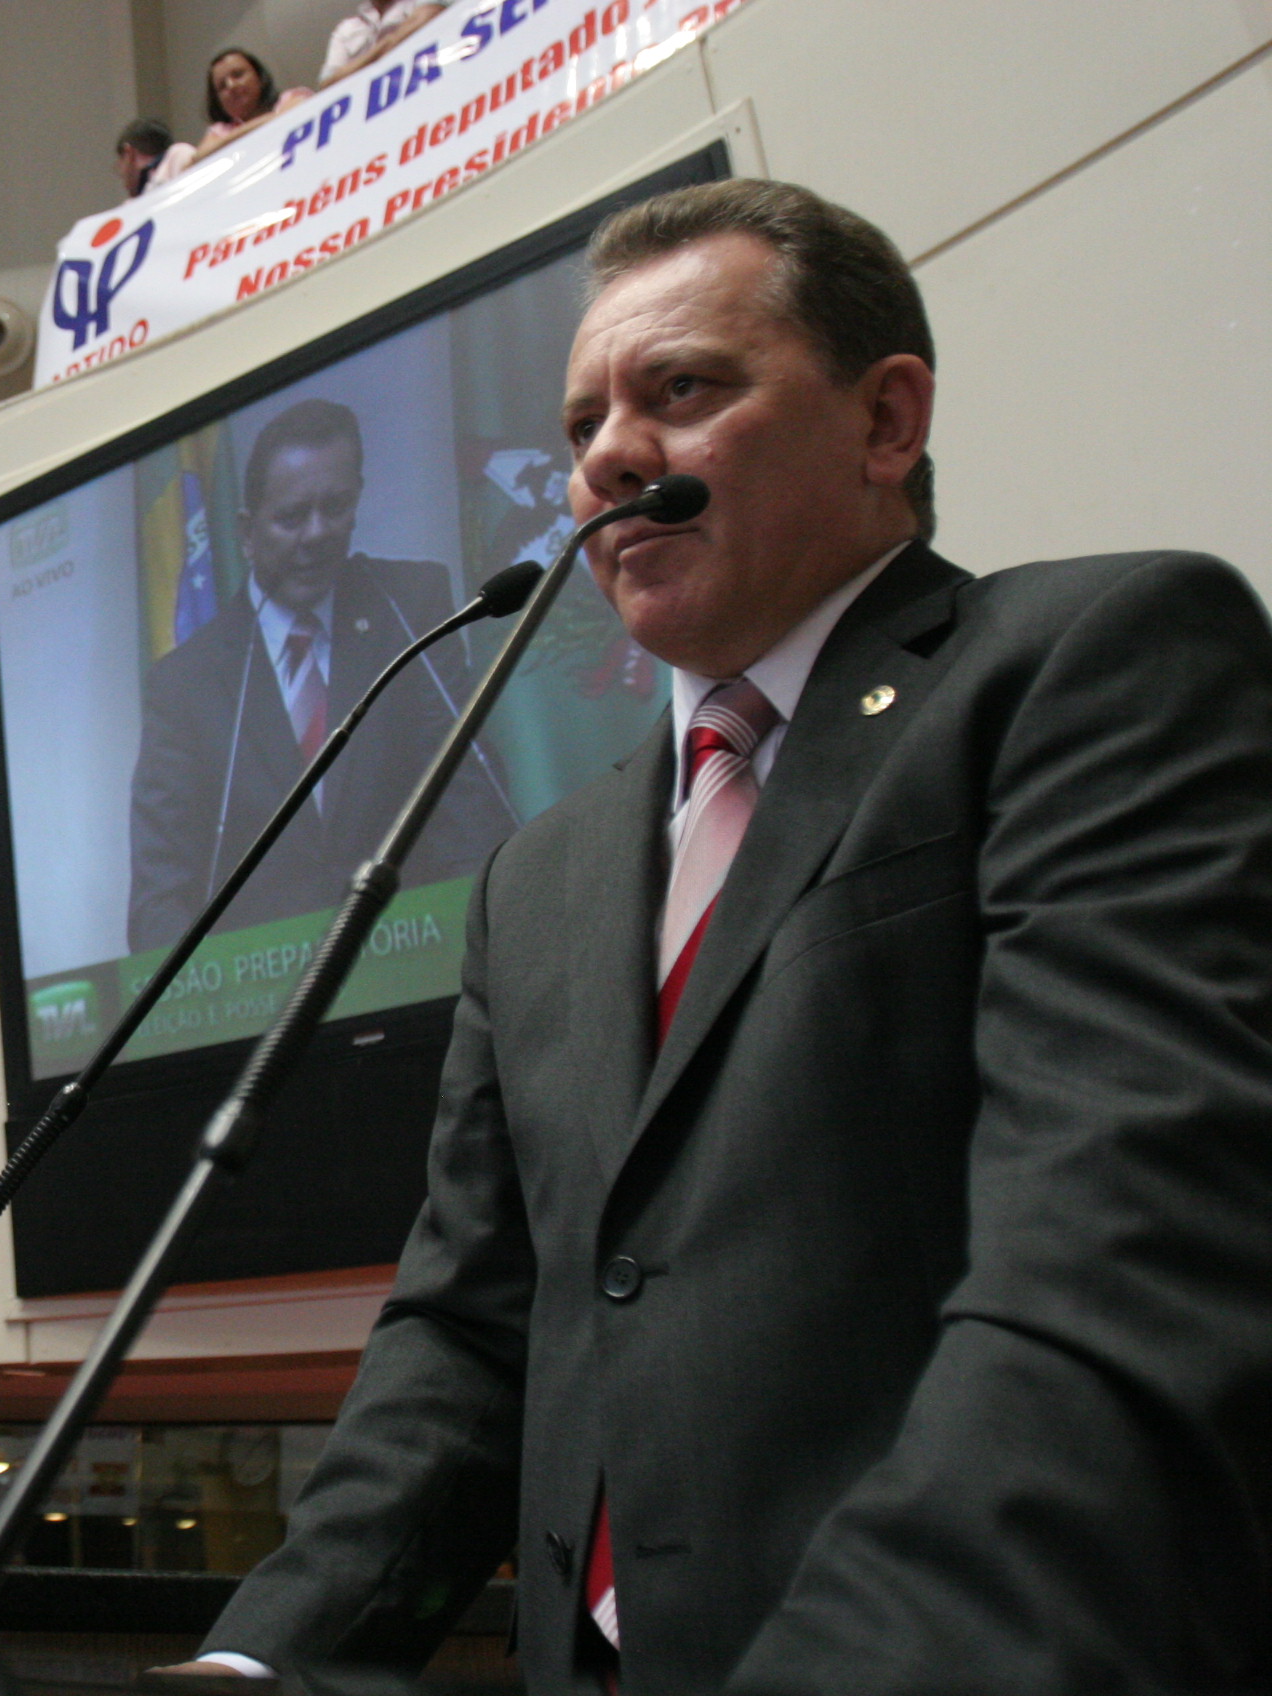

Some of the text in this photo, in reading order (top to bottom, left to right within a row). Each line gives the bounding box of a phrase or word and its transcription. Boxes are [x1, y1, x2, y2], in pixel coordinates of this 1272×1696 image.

[183, 0, 632, 281] Parabéns deputado
[280, 94, 352, 169] PP
[365, 41, 442, 122] DA
